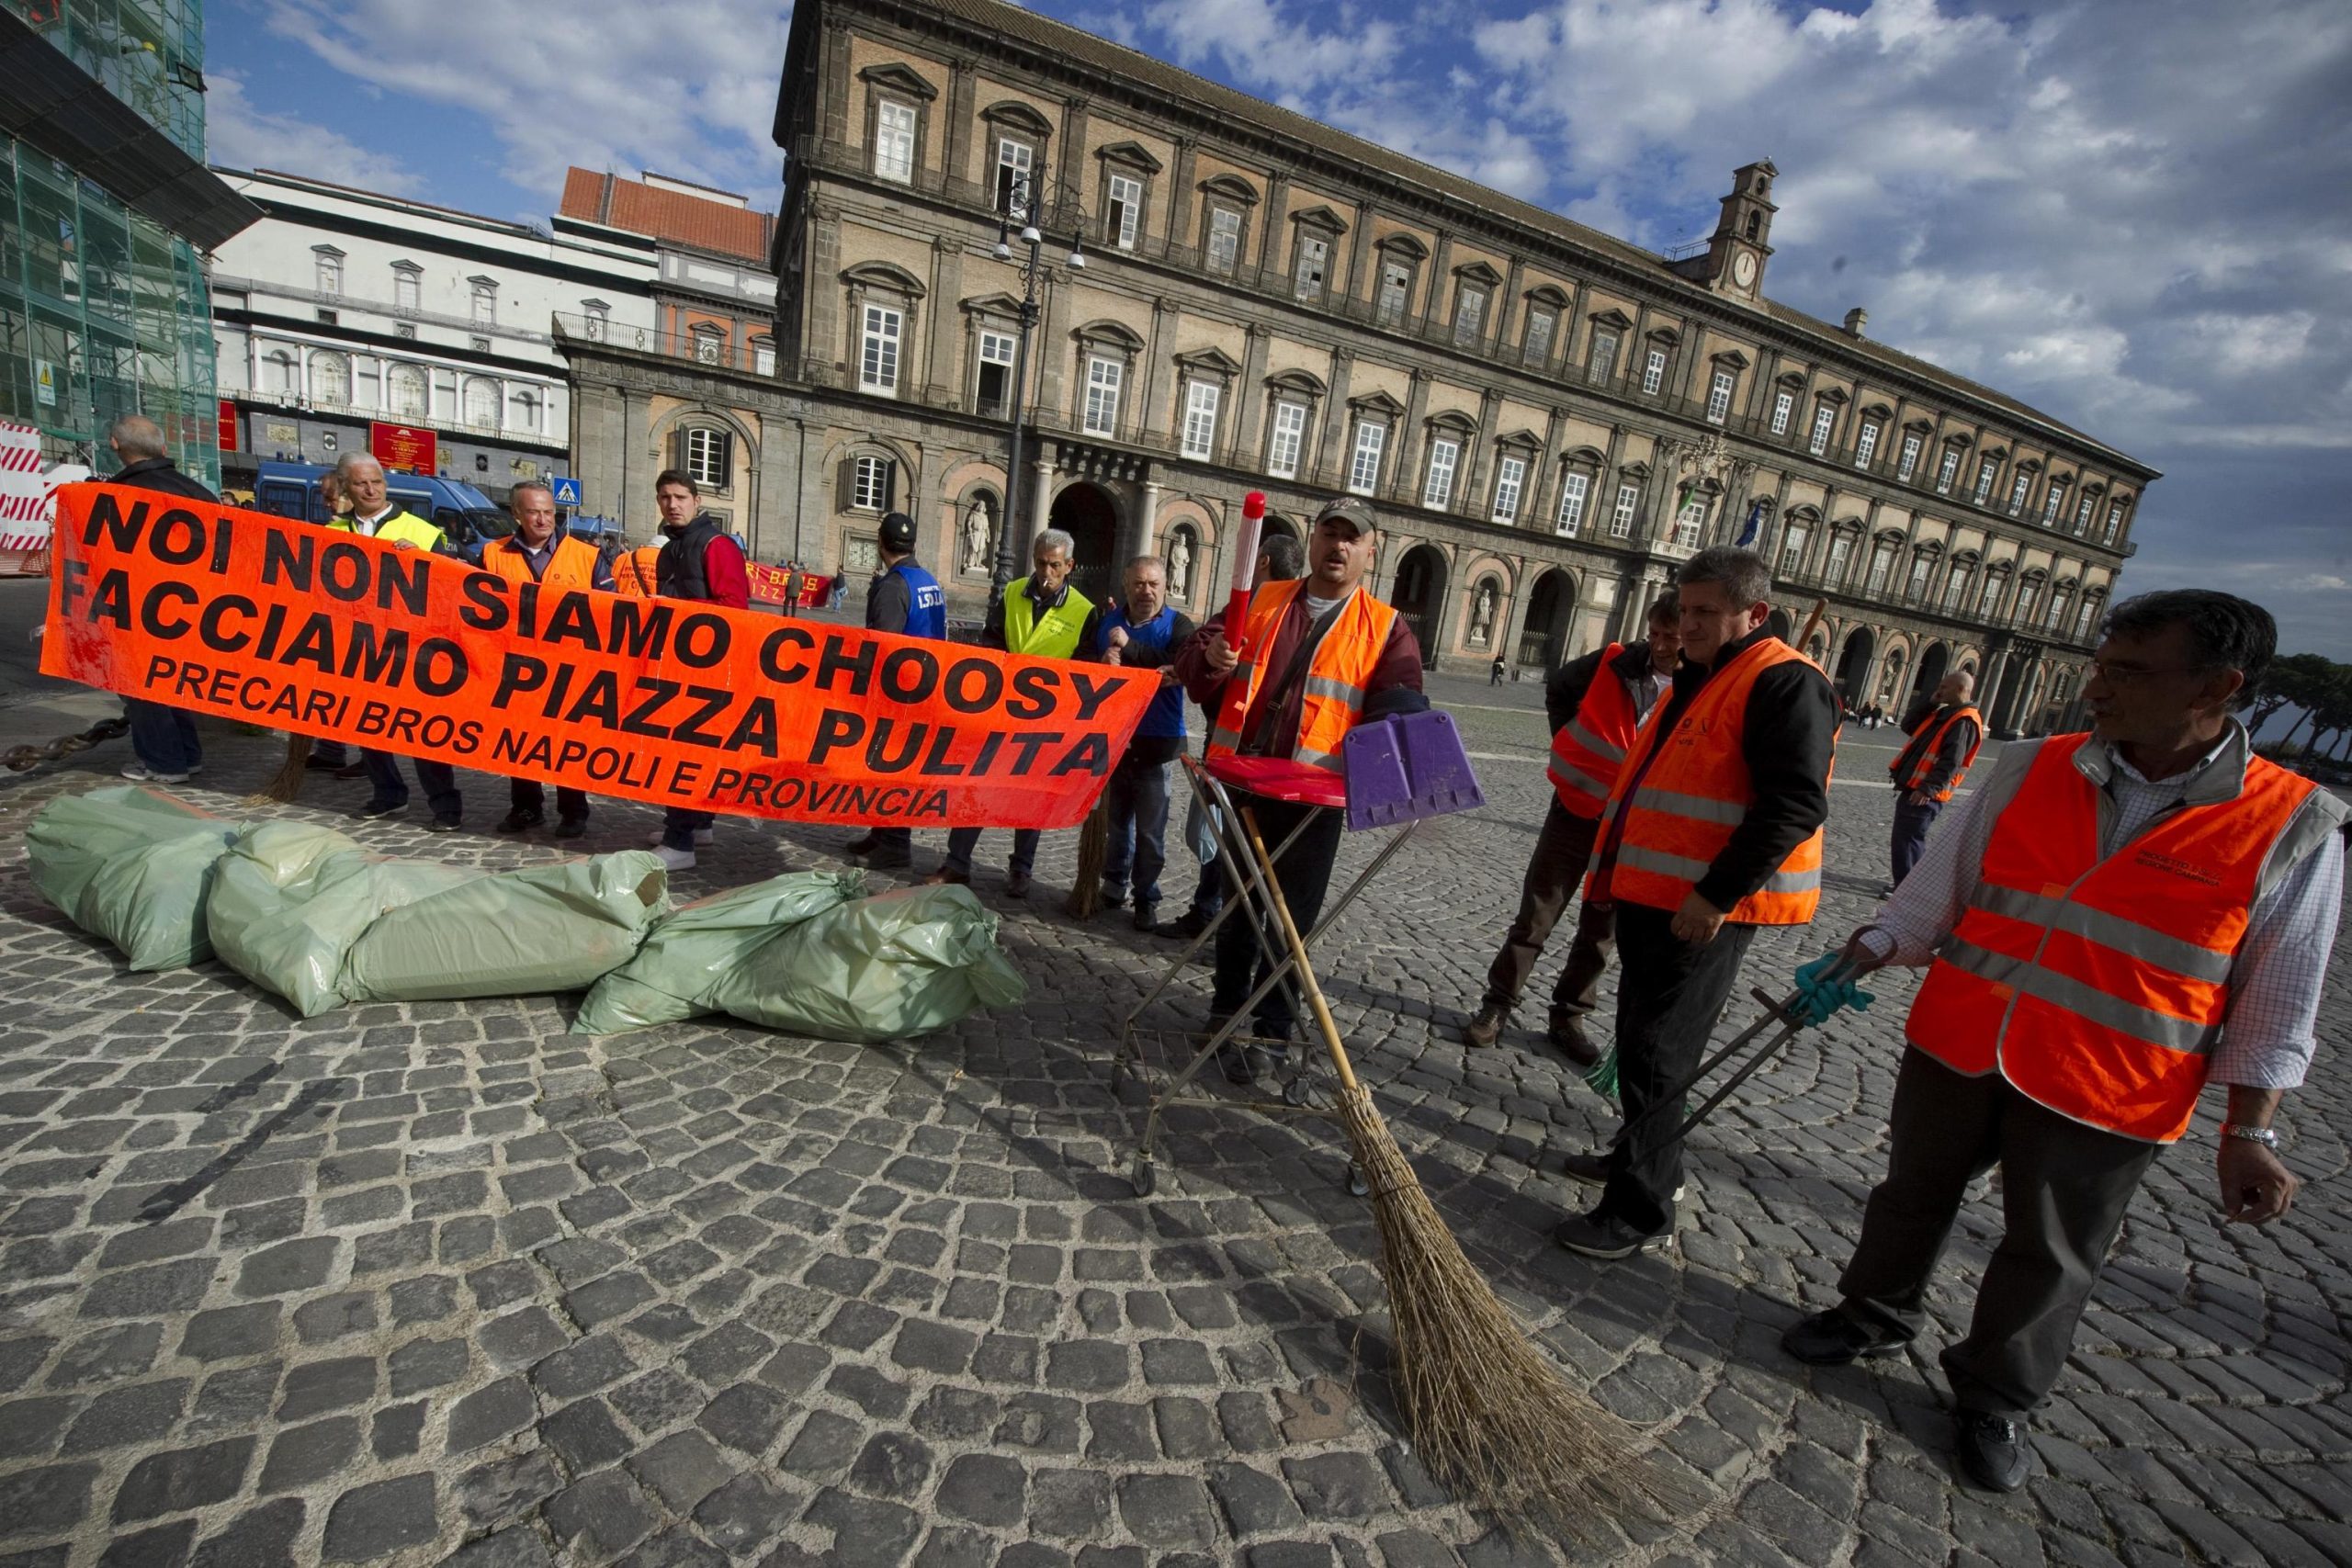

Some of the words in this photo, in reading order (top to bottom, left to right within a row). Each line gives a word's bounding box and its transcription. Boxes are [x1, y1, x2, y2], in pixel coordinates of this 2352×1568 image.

[61, 558, 469, 697] FACCIAMO
[492, 652, 778, 758] PIAZZA
[808, 708, 1110, 777] PULITA
[83, 492, 233, 574] NOI
[261, 528, 431, 616] NON
[459, 572, 731, 669] SIAMO
[759, 627, 1126, 720] CHOOSY
[145, 655, 350, 728] PRECARI
[356, 701, 483, 755] BROS
[492, 728, 661, 790] NAPOLI
[669, 761, 702, 796] E
[708, 768, 948, 818] PROVINCIA
